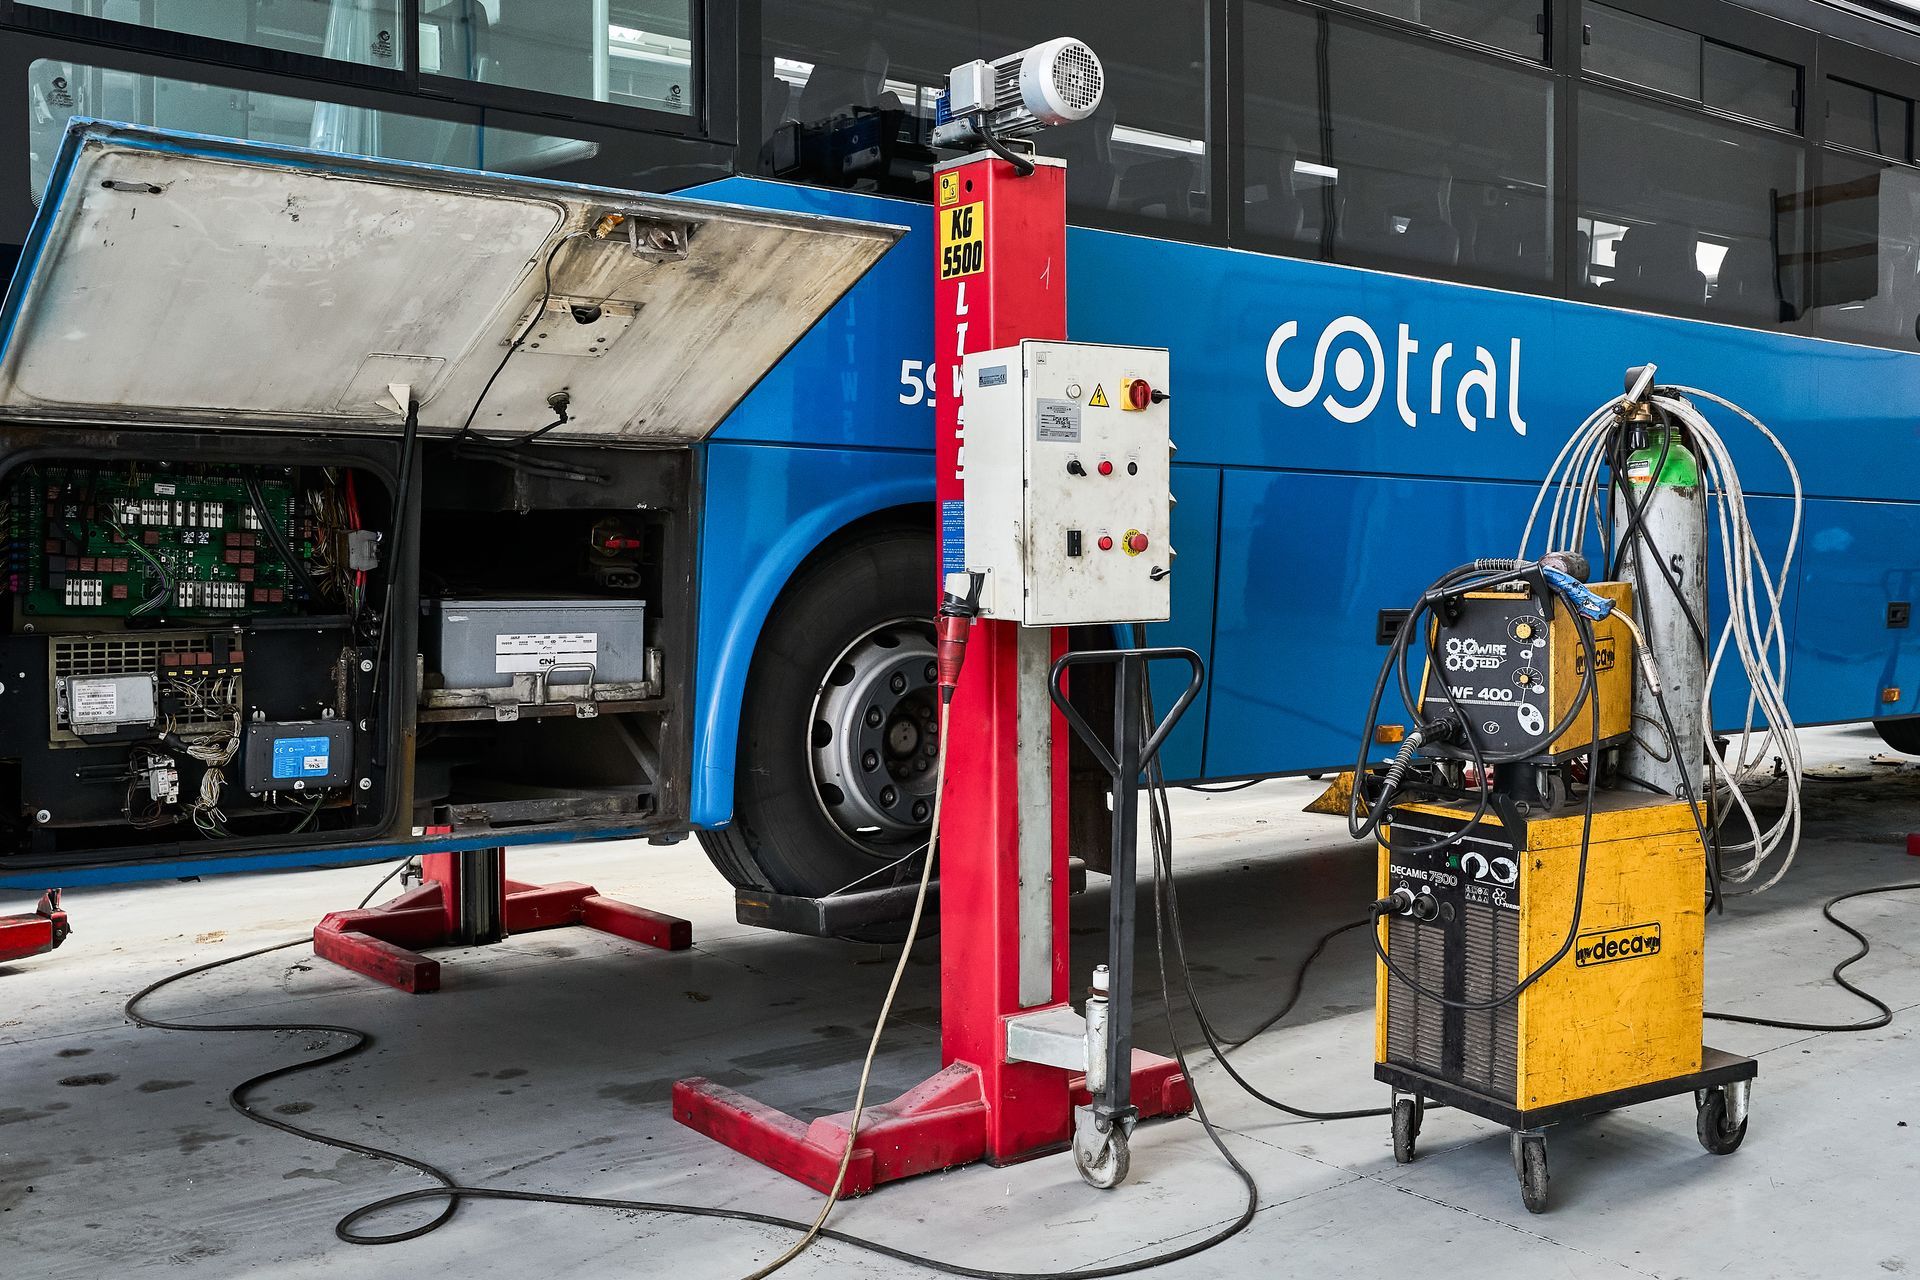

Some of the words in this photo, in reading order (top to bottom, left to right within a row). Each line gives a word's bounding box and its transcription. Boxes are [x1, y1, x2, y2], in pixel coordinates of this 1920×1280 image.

[951, 206, 973, 241] KG
[942, 240, 982, 278] 5500
[1265, 315, 1527, 436] cotral
[1477, 643, 1507, 656] WIRE
[1476, 657, 1500, 669] FEED
[1448, 685, 1473, 699] WF
[1478, 688, 1513, 701] 400
[1390, 864, 1428, 880] DECAMIG
[1428, 870, 1458, 887] 7500
[1593, 936, 1643, 960] deca
